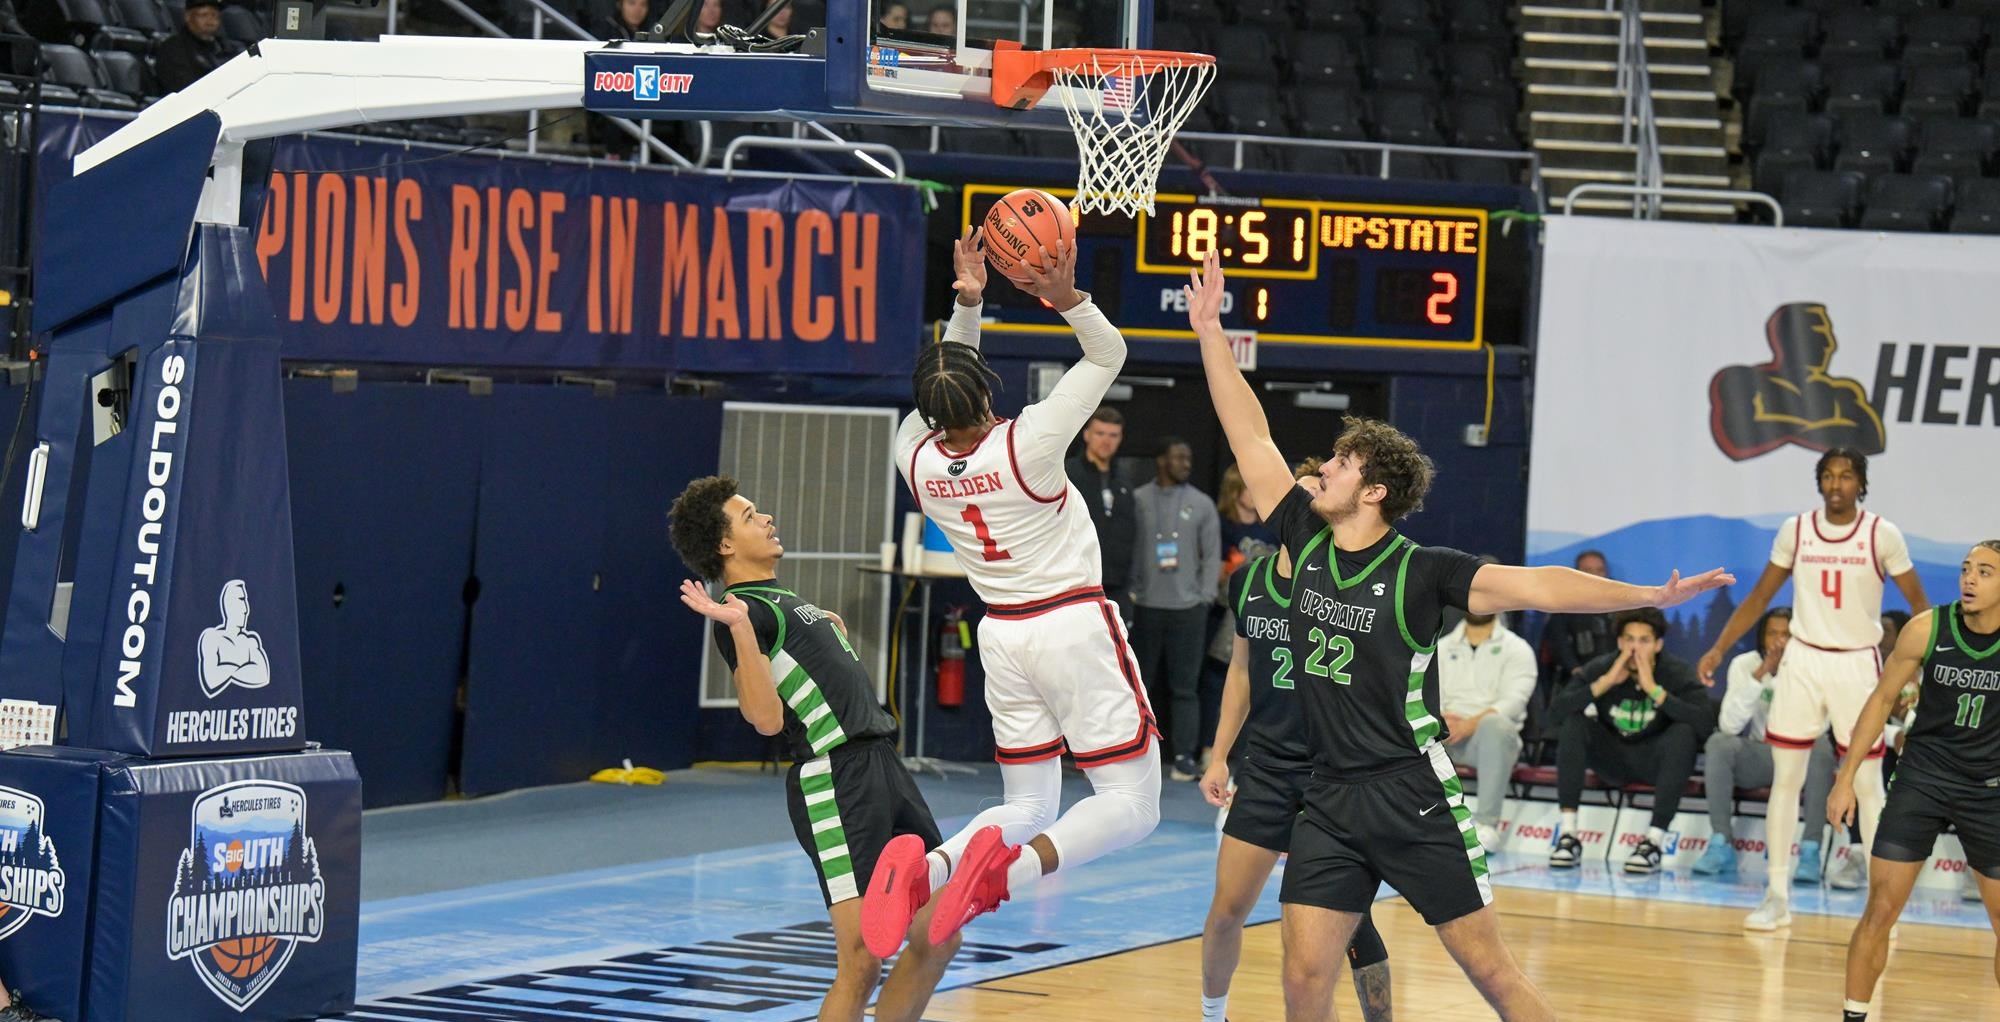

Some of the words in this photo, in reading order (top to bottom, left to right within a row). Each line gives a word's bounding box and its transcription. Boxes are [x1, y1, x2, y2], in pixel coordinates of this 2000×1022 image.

[594, 72, 635, 91] FOOD
[659, 73, 693, 93] CITY
[988, 207, 1031, 258] SPALDING
[1171, 208, 1305, 264] 18:51
[1320, 215, 1479, 253] UPSTATE
[449, 184, 565, 332] RISE
[588, 195, 638, 334] IN
[659, 201, 880, 342] MARCH
[1257, 288, 1268, 320] 1
[1427, 272, 1458, 324] 2
[1871, 343, 2000, 427] HER
[925, 471, 1004, 498] SELDEN
[113, 354, 185, 708] SOLDOUT.COM
[960, 504, 1013, 562] 1
[1821, 570, 1842, 609] 4
[1300, 588, 1377, 634] UPSTATE
[830, 622, 860, 662] 4
[1304, 627, 1355, 685] 22
[1271, 647, 1295, 690] 2
[166, 709, 250, 743] HERCULES
[251, 706, 297, 739] TIRES
[1954, 693, 1986, 729] 11
[231, 798, 263, 812] HERCULES
[263, 797, 282, 809] TIRES
[1516, 825, 1552, 840] FOOD
[1678, 837, 1708, 851] CITY
[225, 849, 244, 863] BIG
[171, 882, 321, 953] CHAMPIONSHIPS
